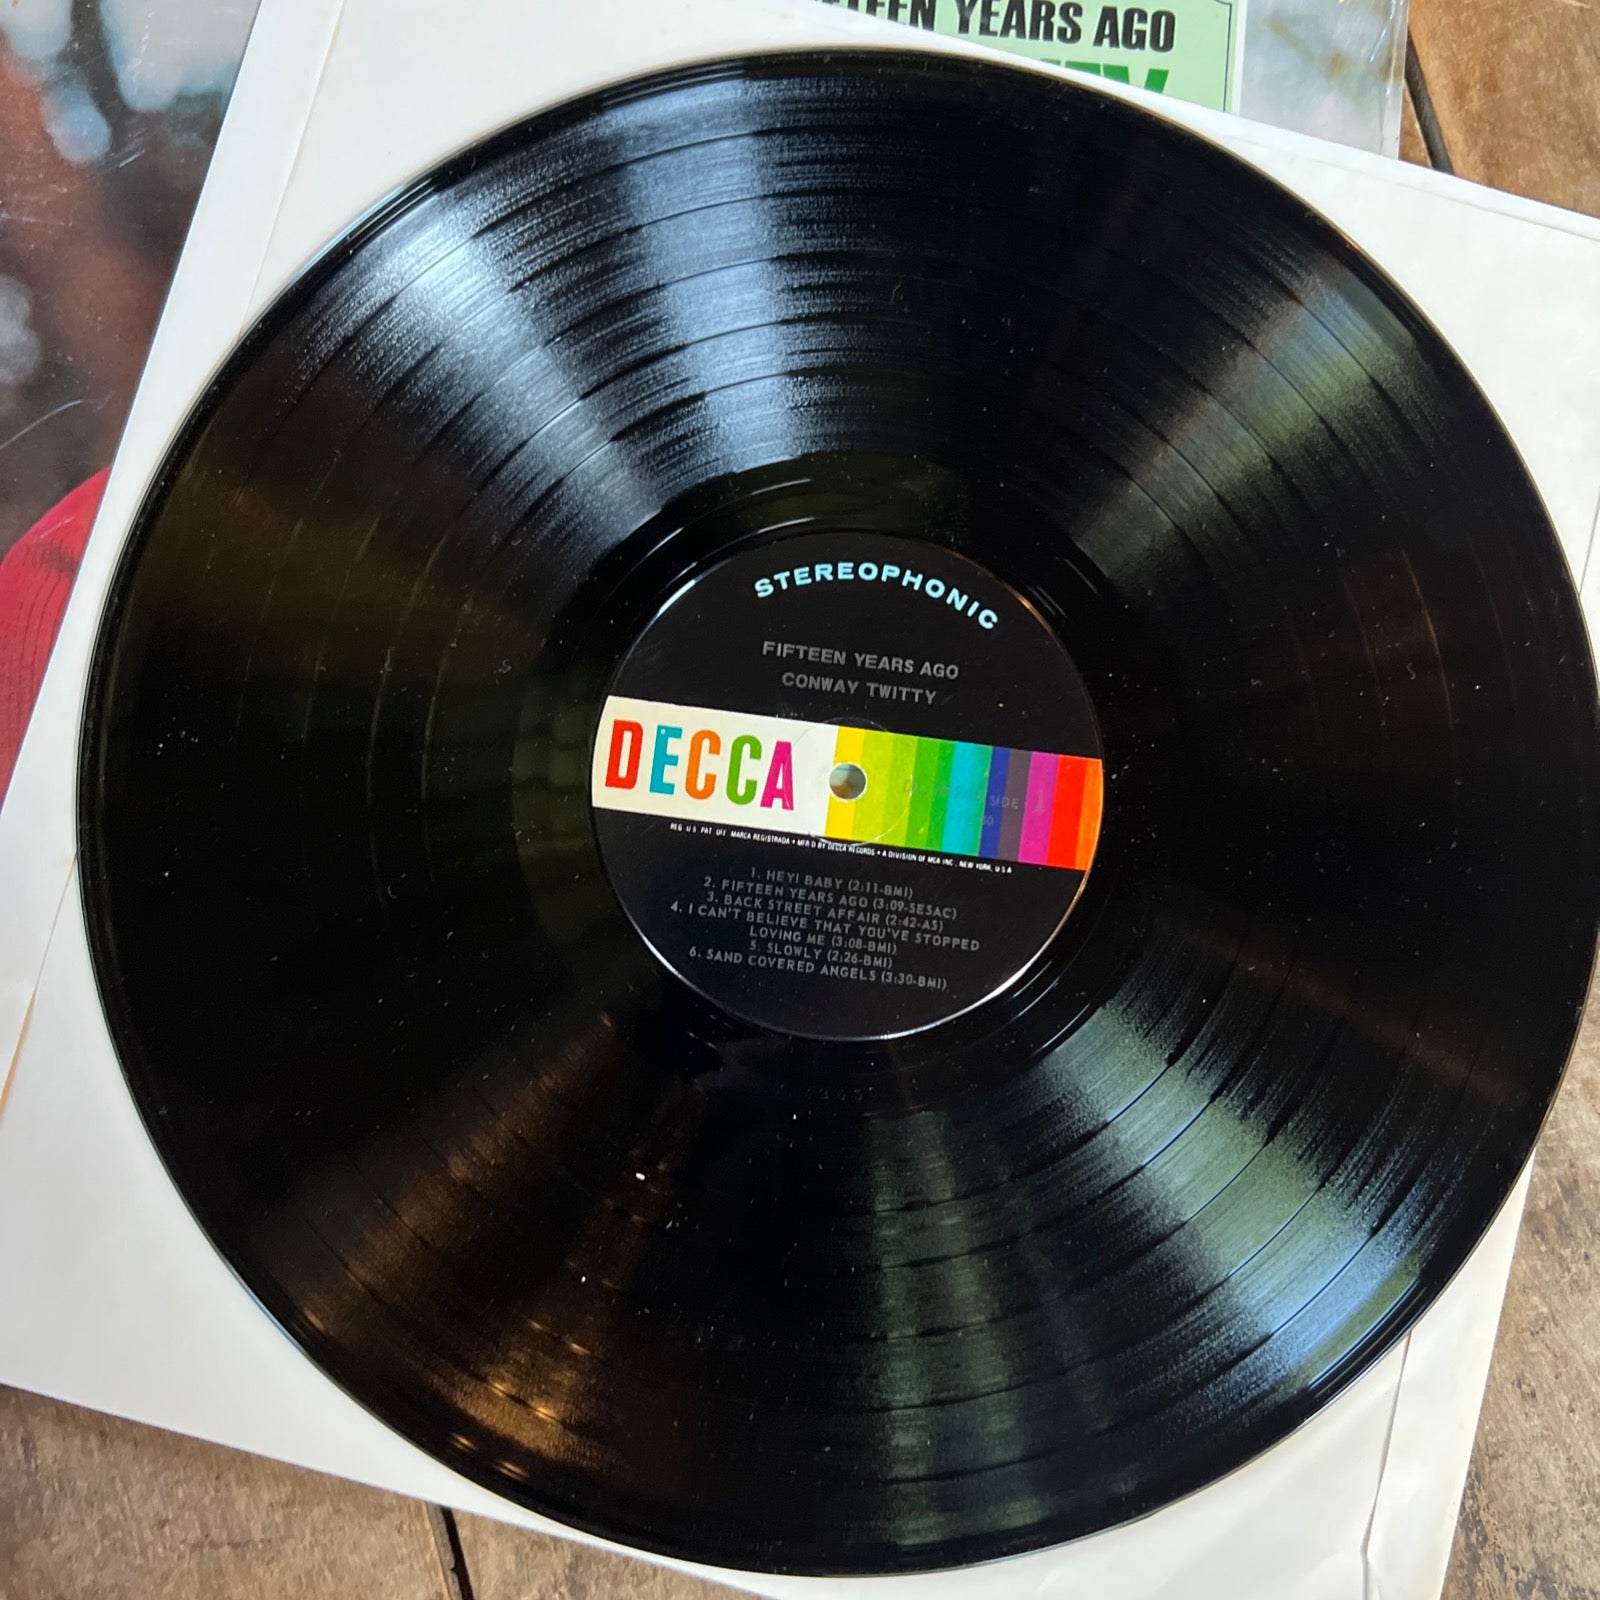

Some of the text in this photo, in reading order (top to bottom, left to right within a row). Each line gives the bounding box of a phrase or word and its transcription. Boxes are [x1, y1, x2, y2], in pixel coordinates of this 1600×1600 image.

[955, 0, 1083, 44] YEARS
[1093, 7, 1176, 53] AGO
[754, 561, 998, 630] STEREOPHONIC
[762, 641, 959, 680] FIFTEEN YEARS AGO
[781, 672, 937, 705] CONWAY TWITTY
[605, 719, 795, 811] DECCA
[989, 795, 1020, 810] SIDE
[730, 830, 751, 840] MARCA
[753, 833, 790, 845] REGISTRADA
[828, 841, 847, 852] DECCA
[849, 845, 875, 857] RECORDS
[888, 850, 917, 861] DIVISION
[927, 856, 940, 865] MCA
[959, 860, 974, 869] NEW
[704, 876, 957, 920] 2. FIFTEEN YEARS AGO (3:09-SESAC)
[804, 874, 843, 890] BABY
[848, 880, 913, 899] (2:11-BMI)
[670, 901, 980, 951] 4. I CAN'T BELIEVE THAT YOU'VE STOPPED
[707, 891, 944, 933] 3. BACK STREET AFFAIR (2:42-AS)
[750, 926, 897, 955] LOVING ME (3:08-BMI)
[750, 939, 893, 969] 5. SLOWLY (2:26-BMI)
[689, 946, 947, 990] 6. SAND COVERED ANGELS (3:30-BMI)
